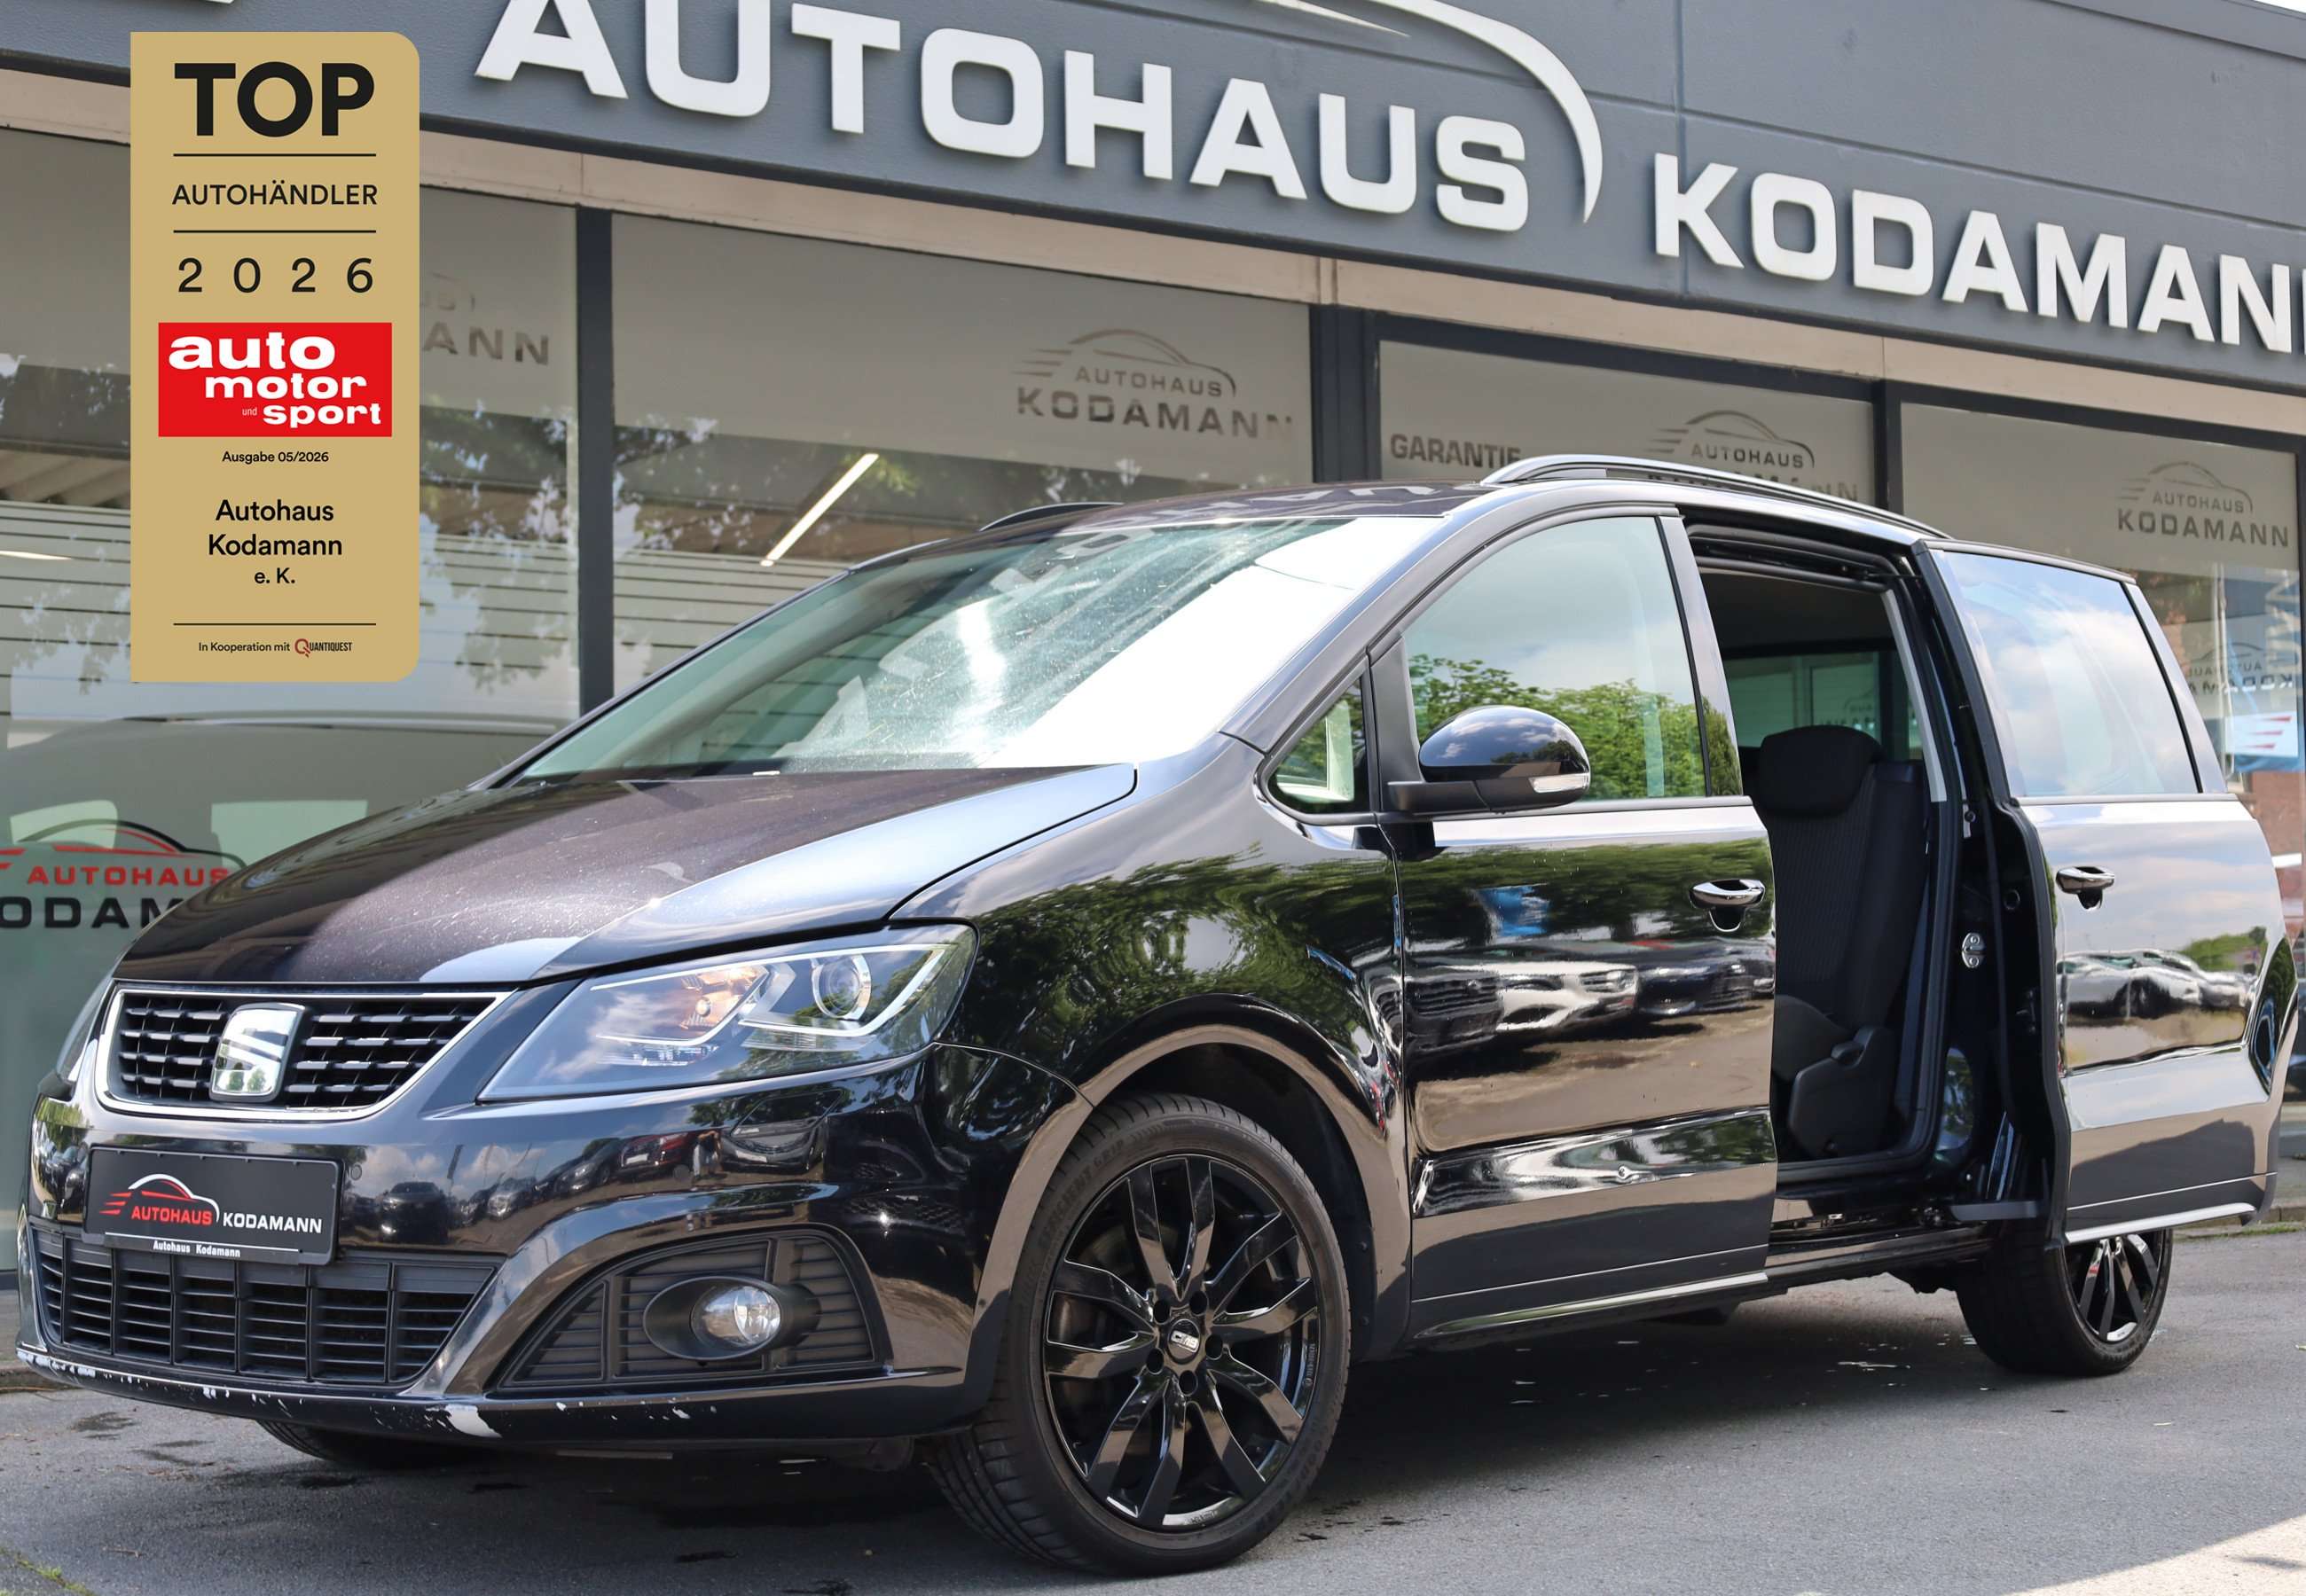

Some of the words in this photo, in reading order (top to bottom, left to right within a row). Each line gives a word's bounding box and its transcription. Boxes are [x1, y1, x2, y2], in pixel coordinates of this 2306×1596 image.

[474, 0, 1529, 232] AUTOHAUS
[1654, 153, 2306, 355] KODAMAN
[1074, 366, 1222, 397] AUTOHAUS
[1016, 387, 1293, 439] KODAMANN
[1690, 442, 1804, 469] AUTOHAUS
[2152, 490, 2245, 513] AUTOHAUS
[2117, 508, 2289, 547] KODAMANN
[131, 1205, 213, 1226] AUTOHAUS
[223, 1212, 322, 1234] KODAMANN
[153, 1240, 191, 1254] Autohaus
[196, 1243, 240, 1258] Kodamann
